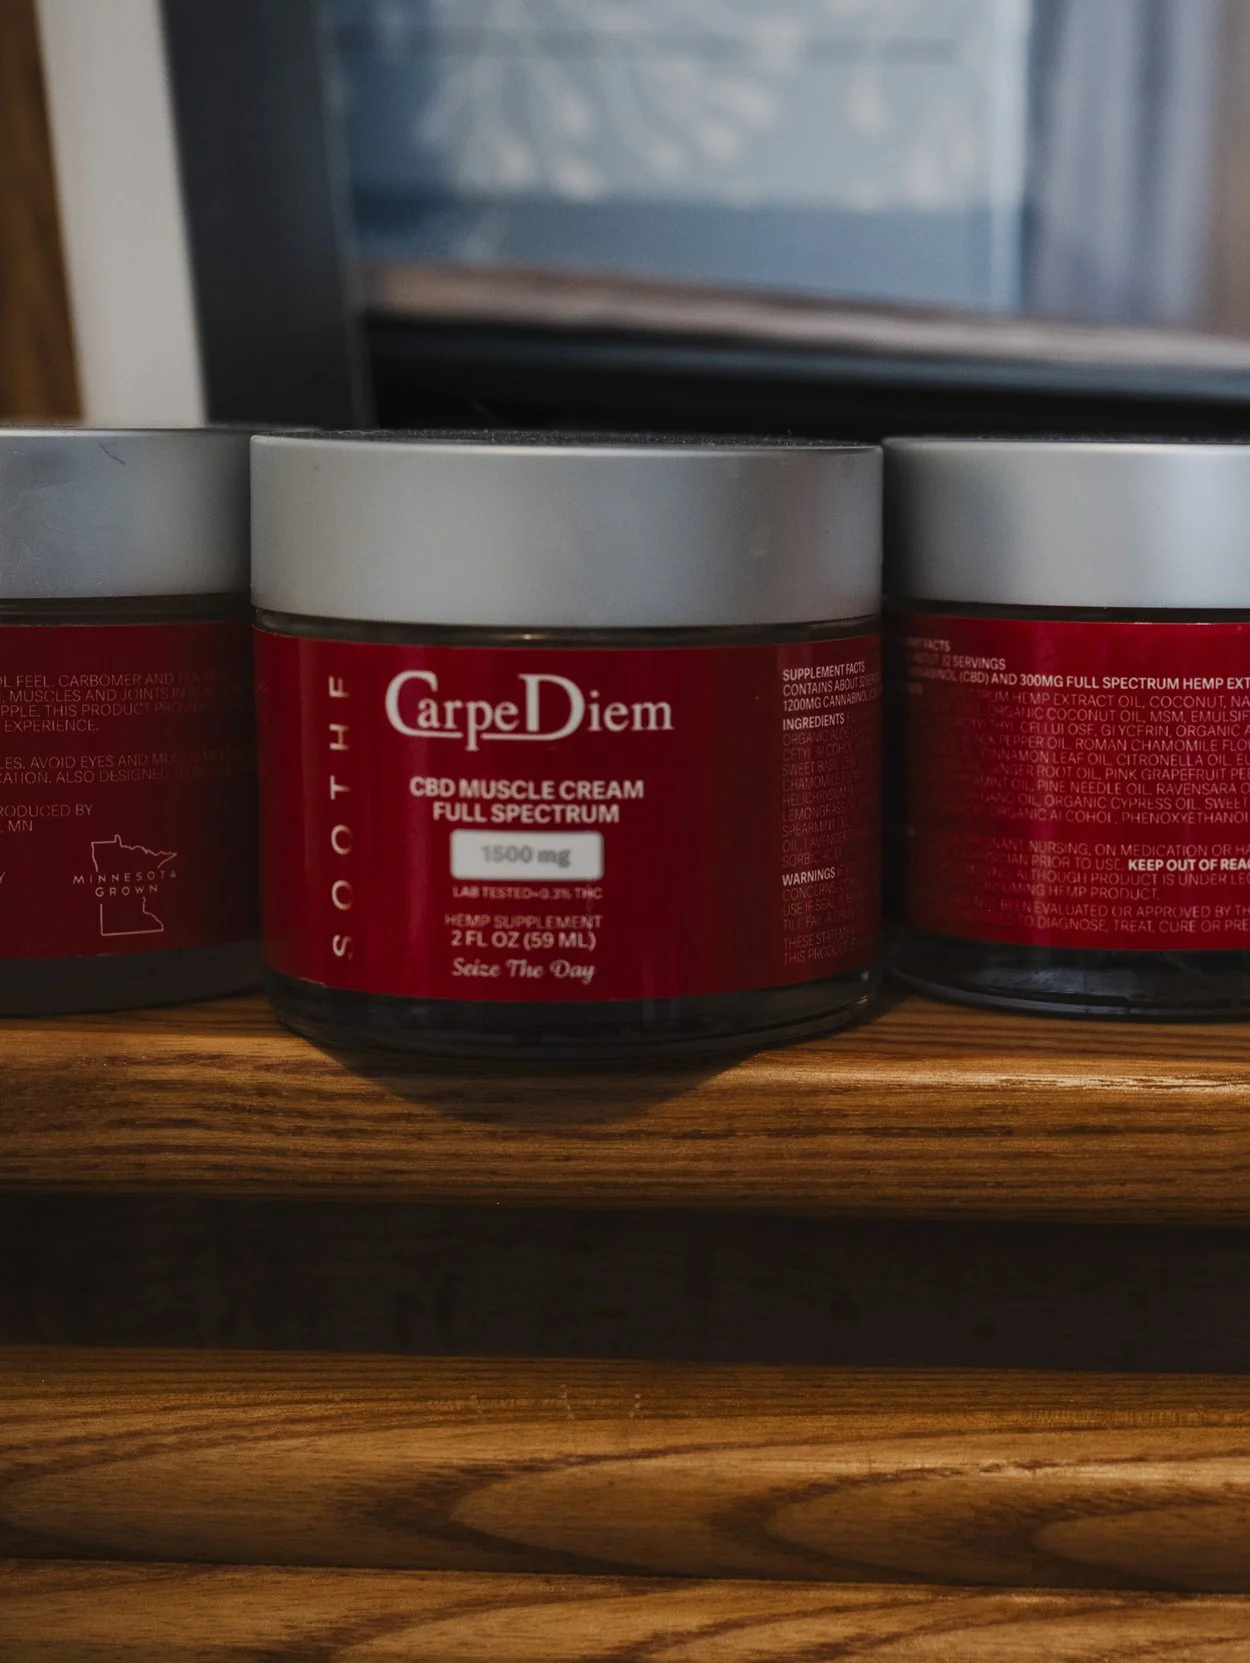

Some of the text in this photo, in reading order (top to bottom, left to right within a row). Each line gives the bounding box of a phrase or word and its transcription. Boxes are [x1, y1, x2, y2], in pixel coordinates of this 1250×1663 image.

[782, 660, 865, 682] SUPPLEMENT FACTS
[952, 655, 1006, 671] SERVINGS
[59, 672, 142, 688] CARBOMER
[145, 672, 174, 686] AND
[782, 677, 858, 697] CONTAINS ABOUT
[990, 672, 1018, 687] AND
[1019, 674, 1064, 689] 300MG
[1066, 676, 1099, 690] FULL
[1102, 677, 1180, 691] SPECTRUM
[1182, 676, 1225, 691] HEMP
[9, 688, 81, 703] MUSCLES
[85, 688, 118, 702] AND
[1012, 692, 1050, 707] HEMP
[1053, 694, 1115, 709] EXTRACT
[46, 703, 78, 717] THIS
[81, 703, 151, 717] PRODUCT
[782, 696, 822, 712] 1200MG
[782, 712, 845, 732] INGREDIENTS
[1046, 707, 1116, 723] COCONUT
[1175, 724, 1241, 738] ORGANIC
[1075, 738, 1128, 753] ROMAN
[1133, 739, 1218, 754] CHAMOMILE
[30, 756, 76, 771] AVOID
[81, 755, 114, 769] EYES
[117, 753, 148, 768] AND
[1116, 753, 1205, 768] CITRONELLA
[56, 770, 95, 785] ALSO
[1105, 768, 1226, 782] PINK GRAPEFRUIT
[409, 776, 646, 800] CBD MUSCLE CREAM
[1156, 783, 1237, 797] RAVENSARA
[75, 802, 94, 817] BY
[432, 801, 621, 824] FULL SPECTRUM
[8, 819, 33, 832] MN
[482, 845, 572, 869] 1500 mg
[1128, 858, 1165, 873] KEEP
[1166, 859, 1196, 873] OUT
[1197, 858, 1218, 872] OF
[72, 869, 178, 887] MINNESOTA
[782, 866, 836, 887] WARNINGS
[95, 885, 159, 898] GROWN
[452, 886, 479, 899] LAB
[574, 887, 604, 900] THC
[445, 913, 603, 930] HEMP SUPPLEMENT
[450, 930, 597, 952] 2 FL OZ (59 ML)
[450, 957, 598, 985] Seize The Day
